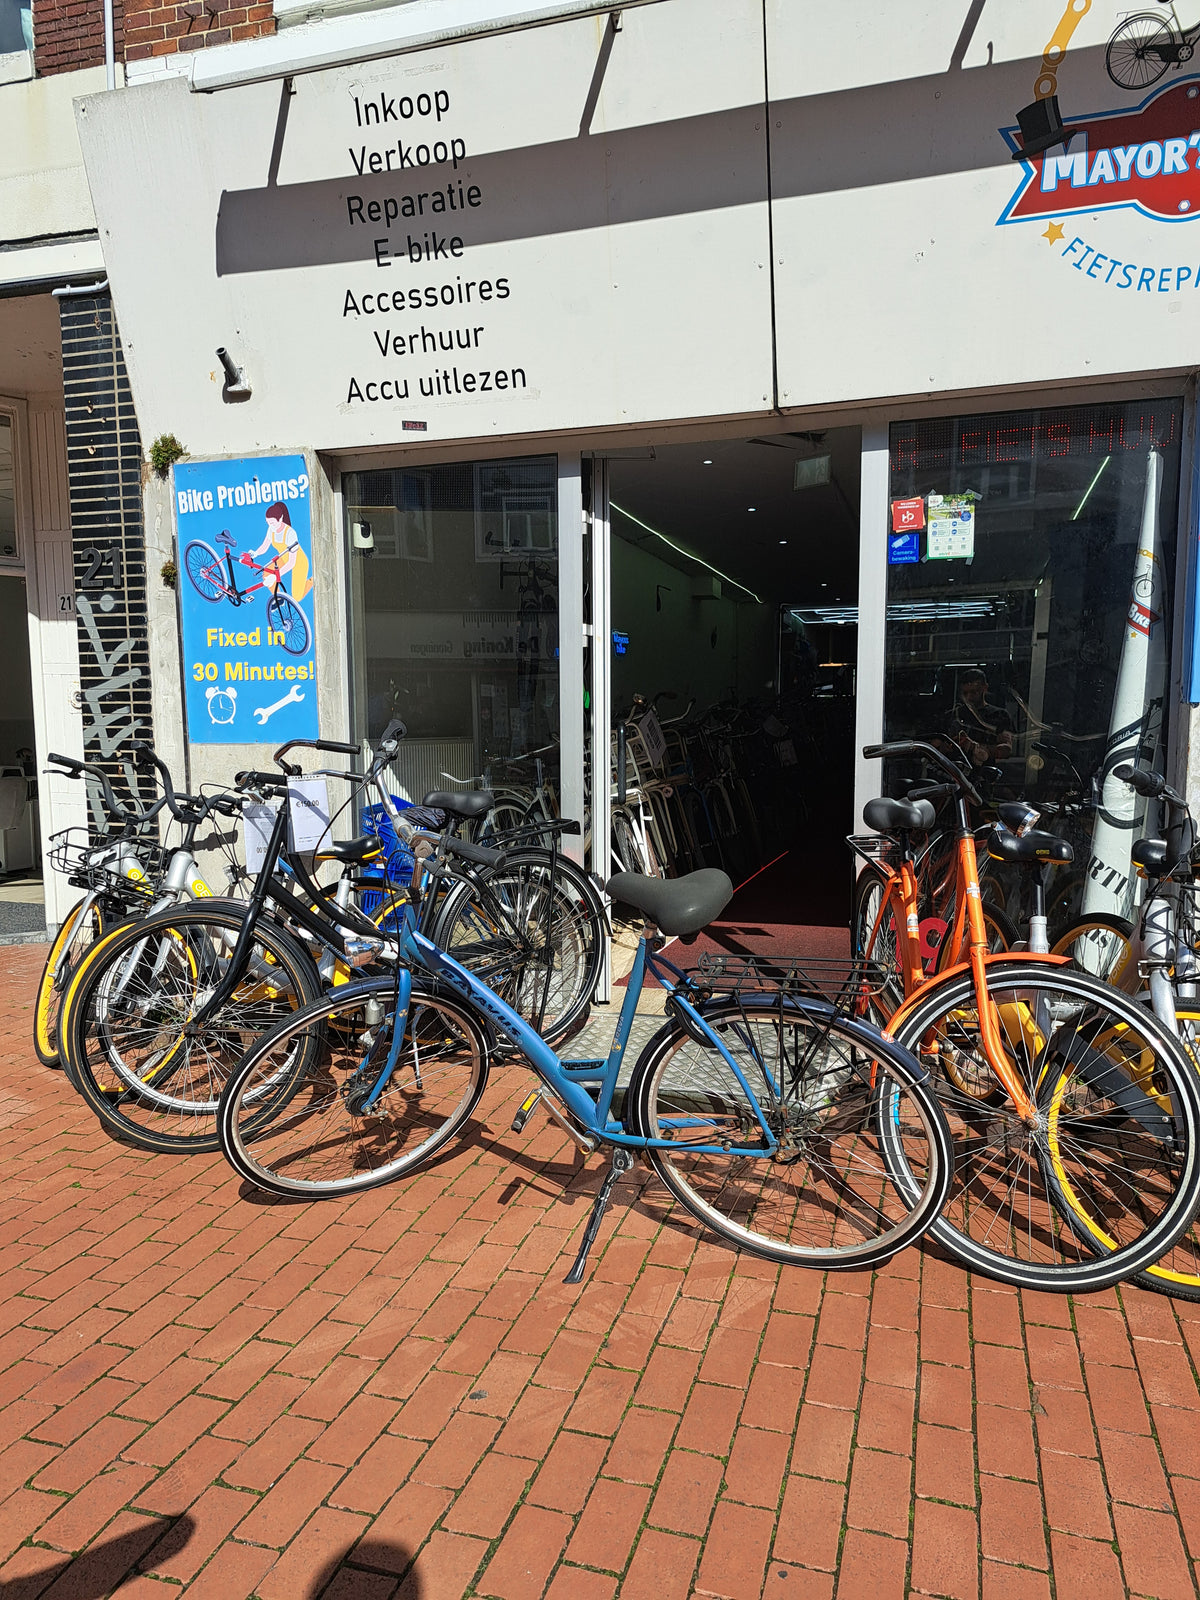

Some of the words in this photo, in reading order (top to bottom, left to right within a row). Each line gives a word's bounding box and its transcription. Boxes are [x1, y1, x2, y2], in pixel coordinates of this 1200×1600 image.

[354, 88, 450, 127] Inkoop
[349, 137, 466, 176] Verkoop
[1041, 130, 1200, 192] MAYOR'
[346, 180, 482, 227] Reparatie
[374, 232, 465, 267] E-bike
[343, 275, 511, 317] Accessoires
[374, 325, 484, 357] Verhuur
[347, 376, 409, 403] Accu
[419, 366, 527, 397] uitlezen
[962, 424, 1070, 465] FIETS
[177, 487, 213, 514] Bike
[218, 474, 309, 509] Problems?
[80, 547, 122, 589] 21
[60, 595, 72, 611] 21
[207, 627, 261, 647] Fixed
[268, 627, 286, 646] in
[193, 662, 218, 682] 30
[225, 661, 315, 682] Minutes!
[440, 968, 522, 1037] BATAVUS
